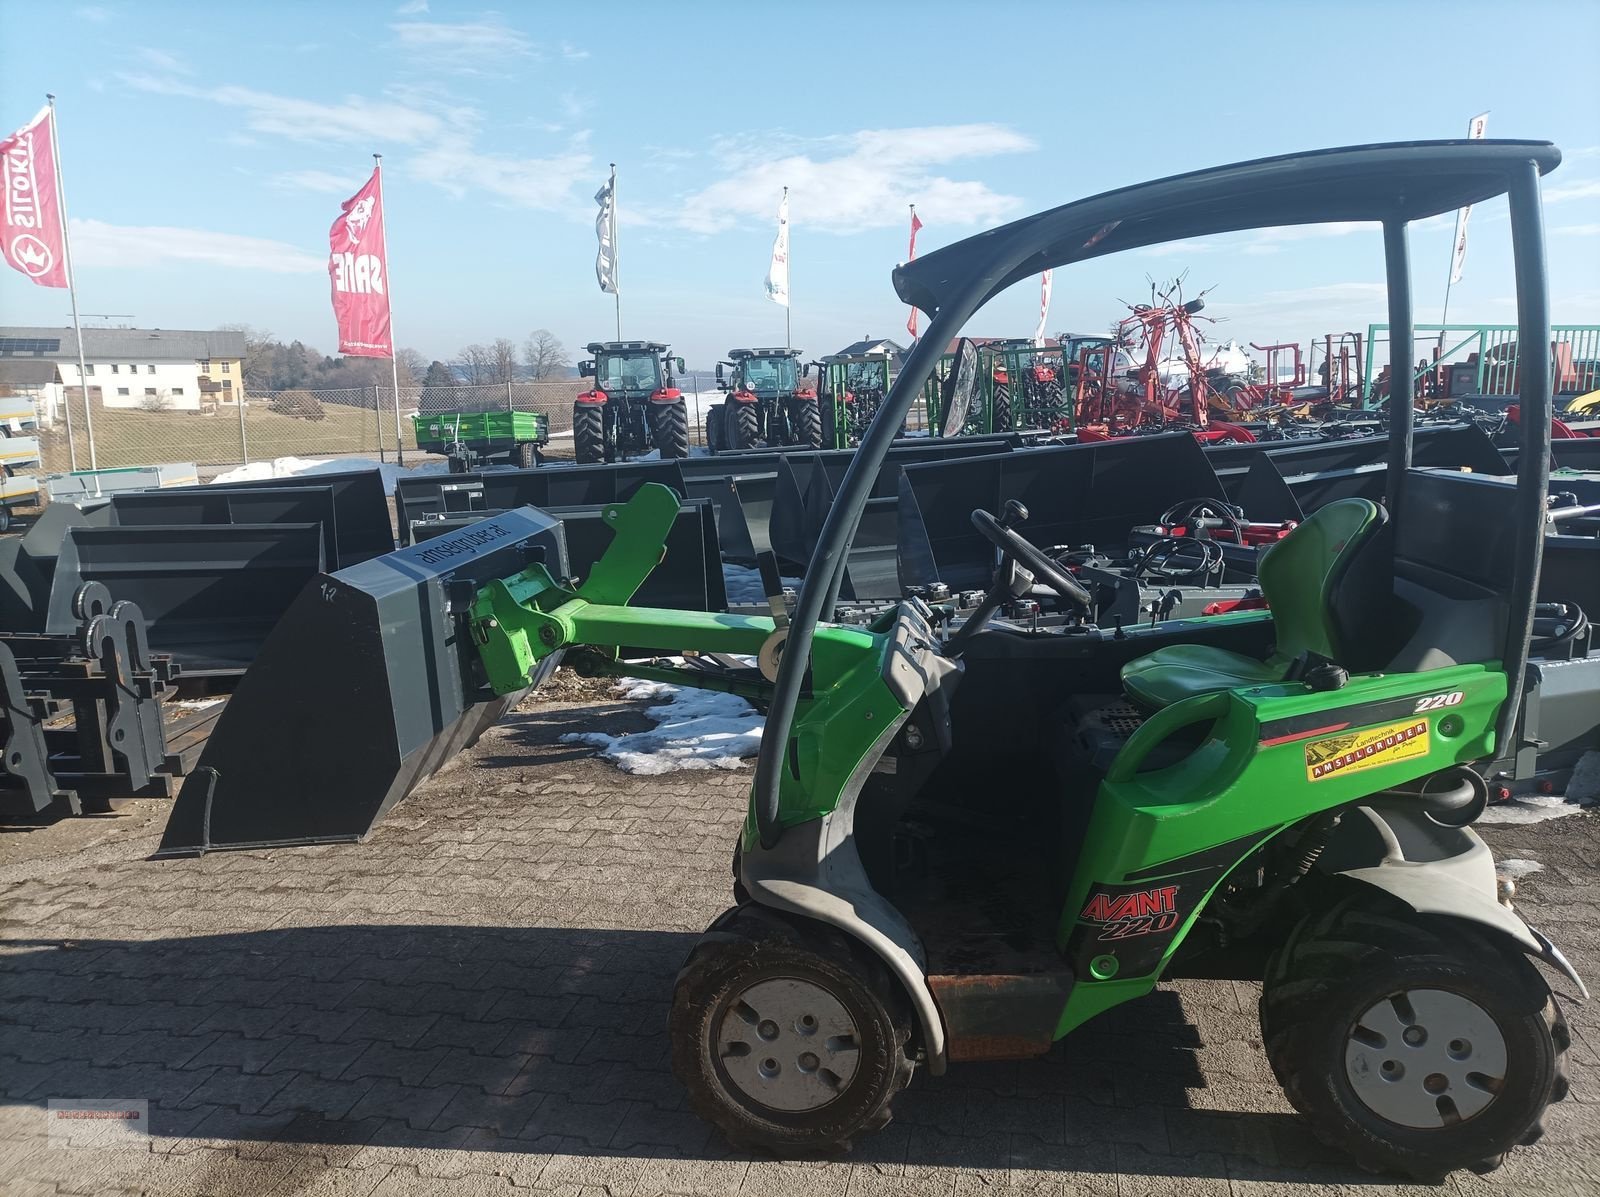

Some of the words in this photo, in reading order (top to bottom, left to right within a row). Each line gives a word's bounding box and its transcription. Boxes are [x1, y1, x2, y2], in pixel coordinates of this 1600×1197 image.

[1414, 691, 1464, 713] 220
[1313, 723, 1426, 777] AMSELGRUBER
[1356, 728, 1395, 748] Landtechnik
[1081, 886, 1178, 921] AVANT
[1098, 912, 1179, 940] 220
